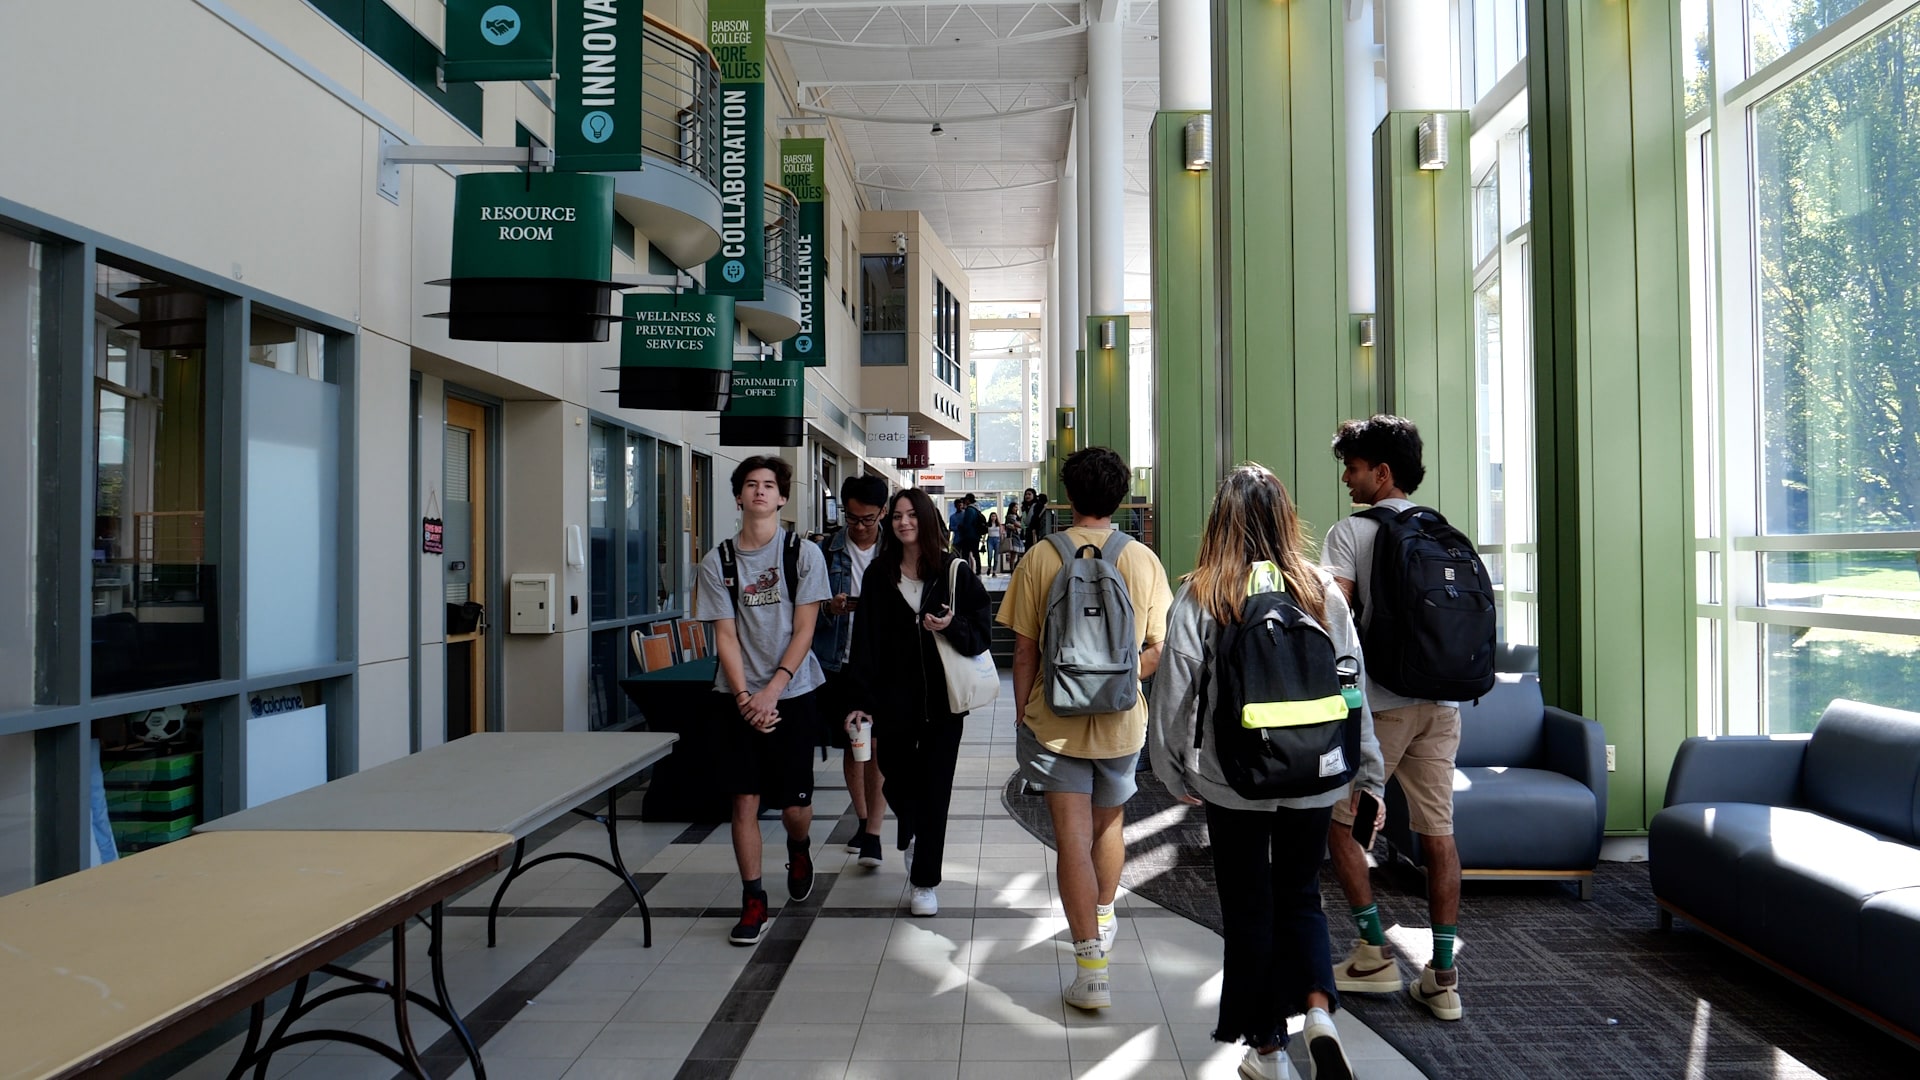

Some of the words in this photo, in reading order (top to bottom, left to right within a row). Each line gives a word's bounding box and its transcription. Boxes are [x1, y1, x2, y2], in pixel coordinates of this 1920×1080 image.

[711, 20, 749, 32] BABSON
[711, 32, 752, 45] COLLEGE
[712, 46, 748, 62] CORE
[720, 62, 761, 79] ALUES
[783, 154, 812, 164] BABSON
[722, 90, 746, 258] COLLABORATION
[783, 163, 815, 173] COLLEGE
[784, 174, 811, 187] CORE
[788, 186, 822, 199] ALUES
[480, 206, 576, 222] RESOURCE
[499, 226, 554, 240] ROOM
[798, 234, 813, 334] EXCELLENCE
[635, 311, 701, 323] WELLNESS
[706, 313, 716, 323] &
[635, 326, 716, 337] PREVENTION
[646, 339, 704, 350] SERVICES
[731, 378, 798, 387] STAINABILITY
[745, 388, 777, 397] OFFICE
[867, 431, 906, 442] create
